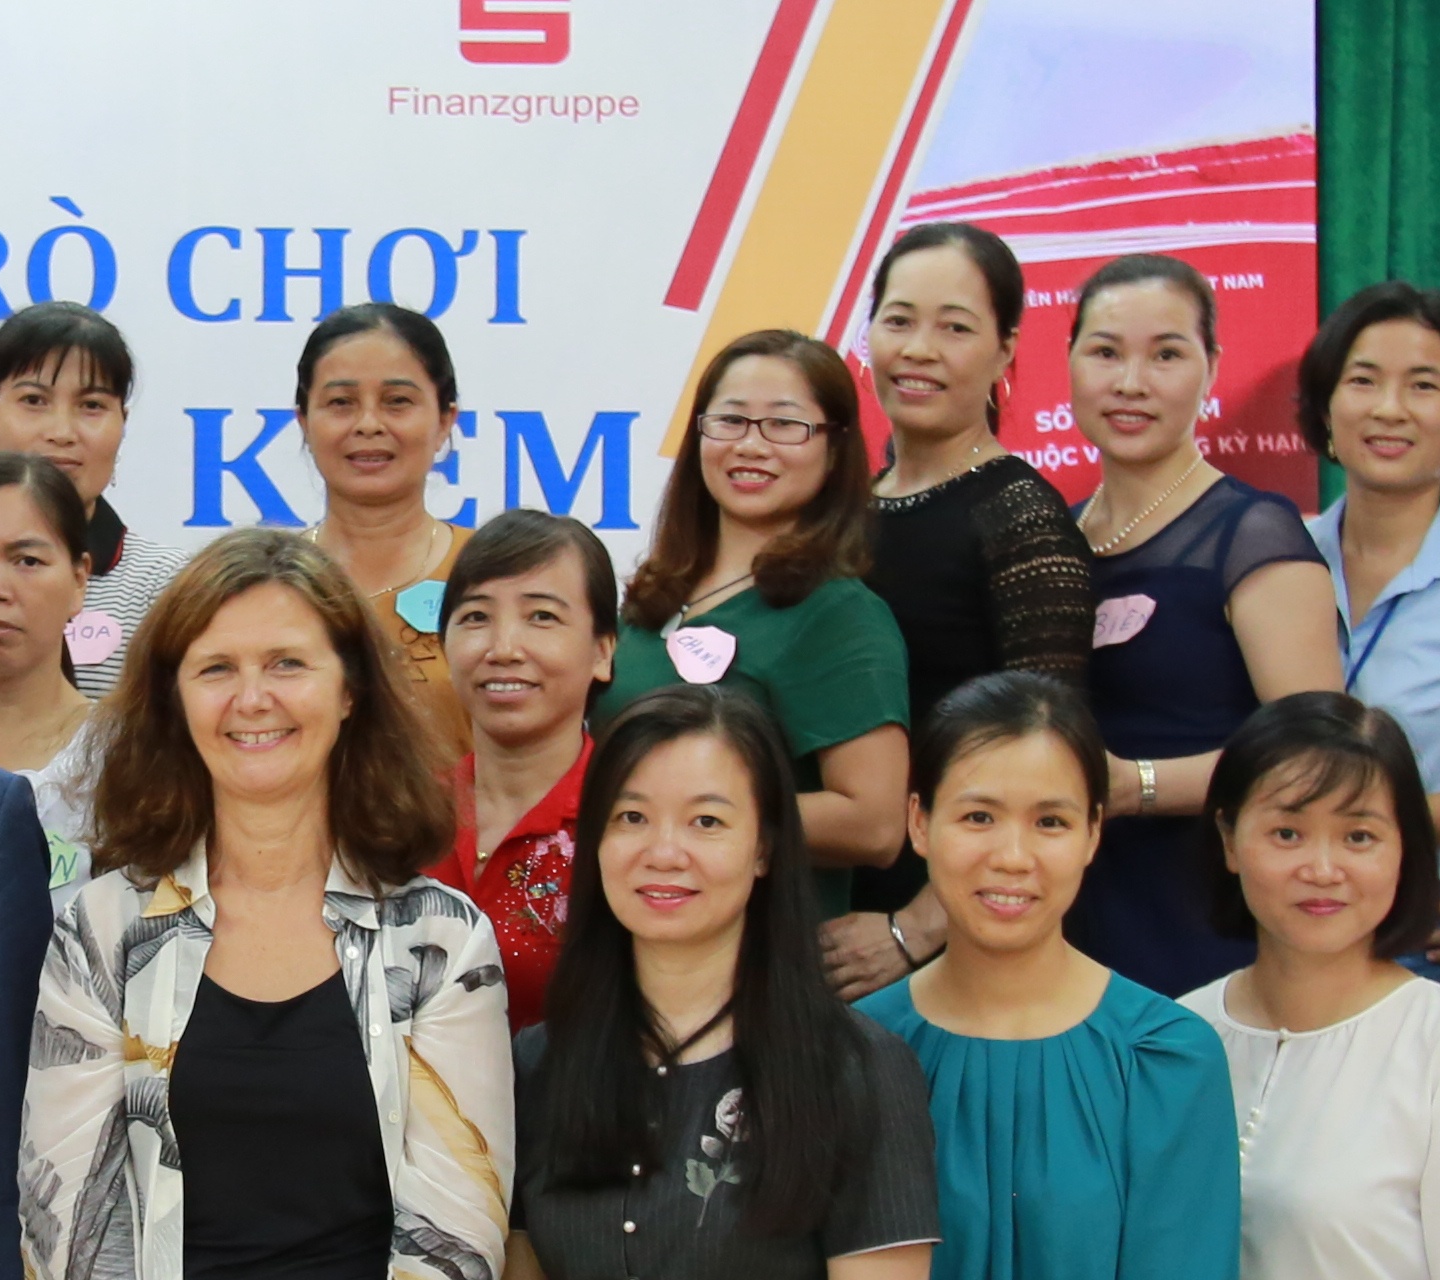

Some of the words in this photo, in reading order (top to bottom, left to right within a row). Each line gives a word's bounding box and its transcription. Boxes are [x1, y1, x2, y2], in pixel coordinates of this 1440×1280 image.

[387, 86, 640, 124] Finanzgruppe
[167, 226, 526, 324] CHƠI
[1222, 273, 1264, 290] NAM
